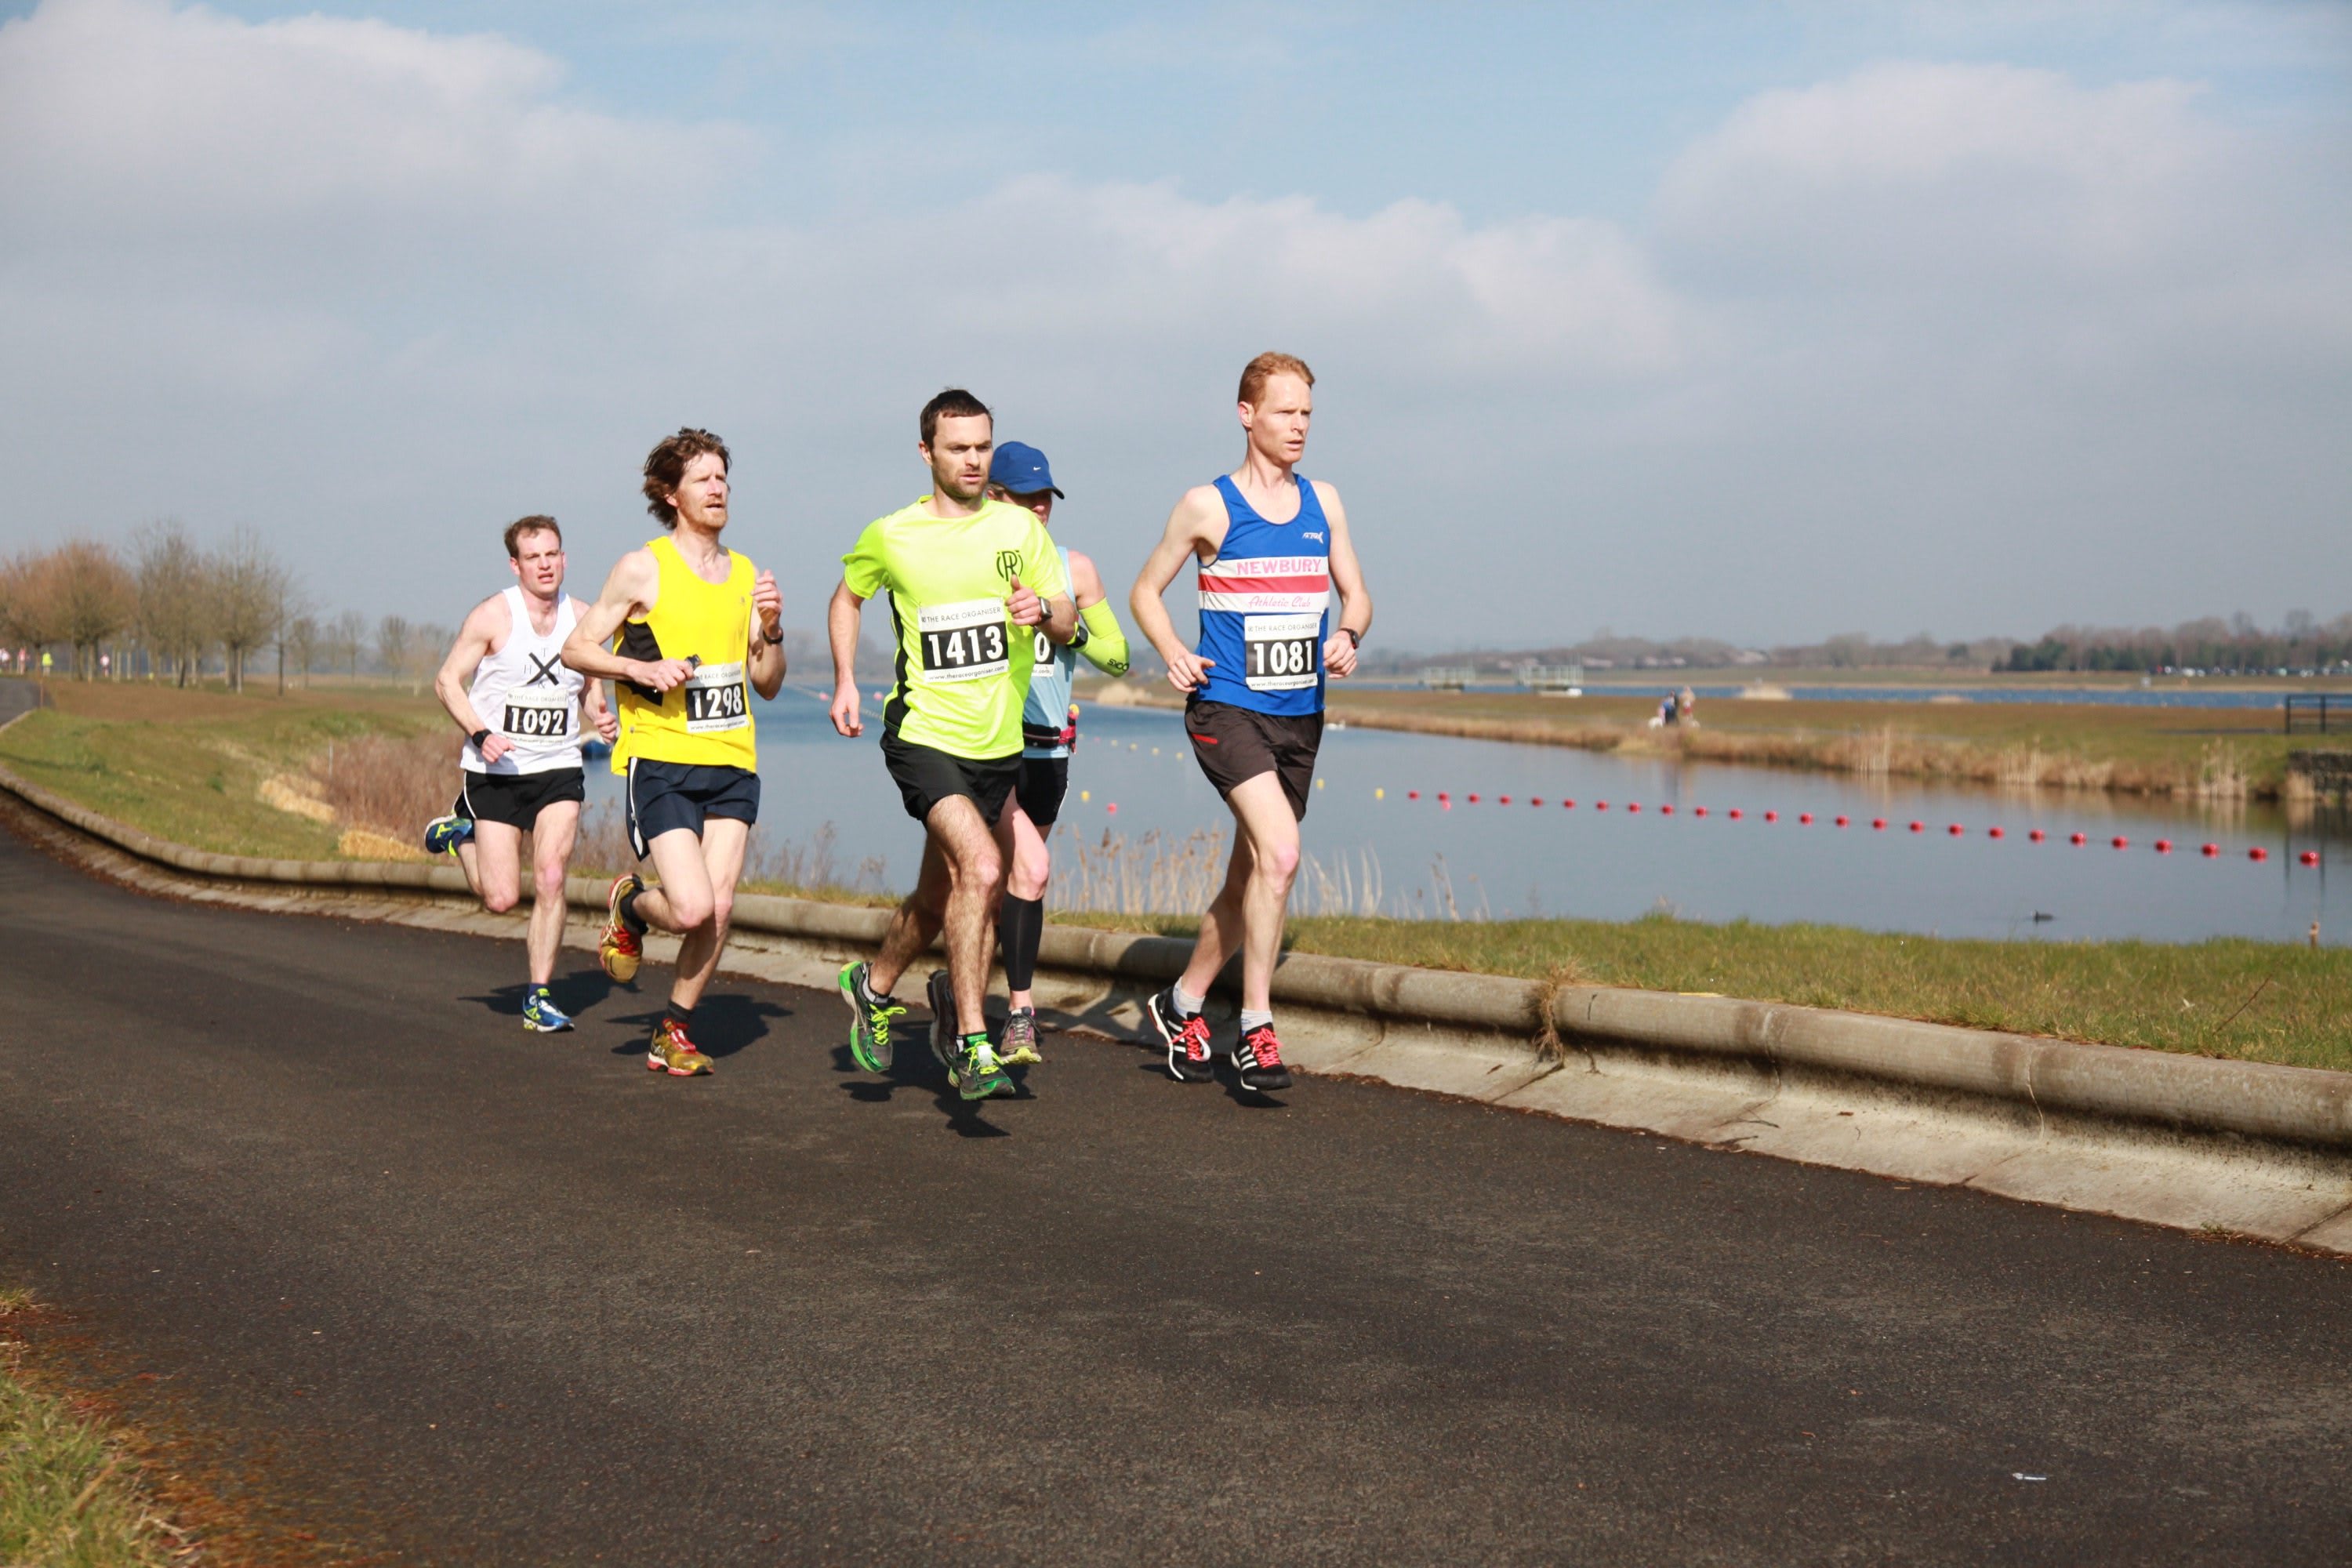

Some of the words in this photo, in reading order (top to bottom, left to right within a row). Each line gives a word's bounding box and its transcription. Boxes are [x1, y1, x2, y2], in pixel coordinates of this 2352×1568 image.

[1236, 558, 1321, 575] NEWBURY
[1248, 595, 1289, 608] Athletic
[1291, 595, 1312, 608] Club
[941, 613, 960, 622] RACE
[961, 607, 1001, 619] ORGANISER
[927, 625, 1004, 667] 1413
[1254, 640, 1312, 674] 1081
[929, 666, 1004, 681] www.theraceorganiser.com
[692, 684, 743, 719] 1298
[511, 706, 564, 735] 1092
